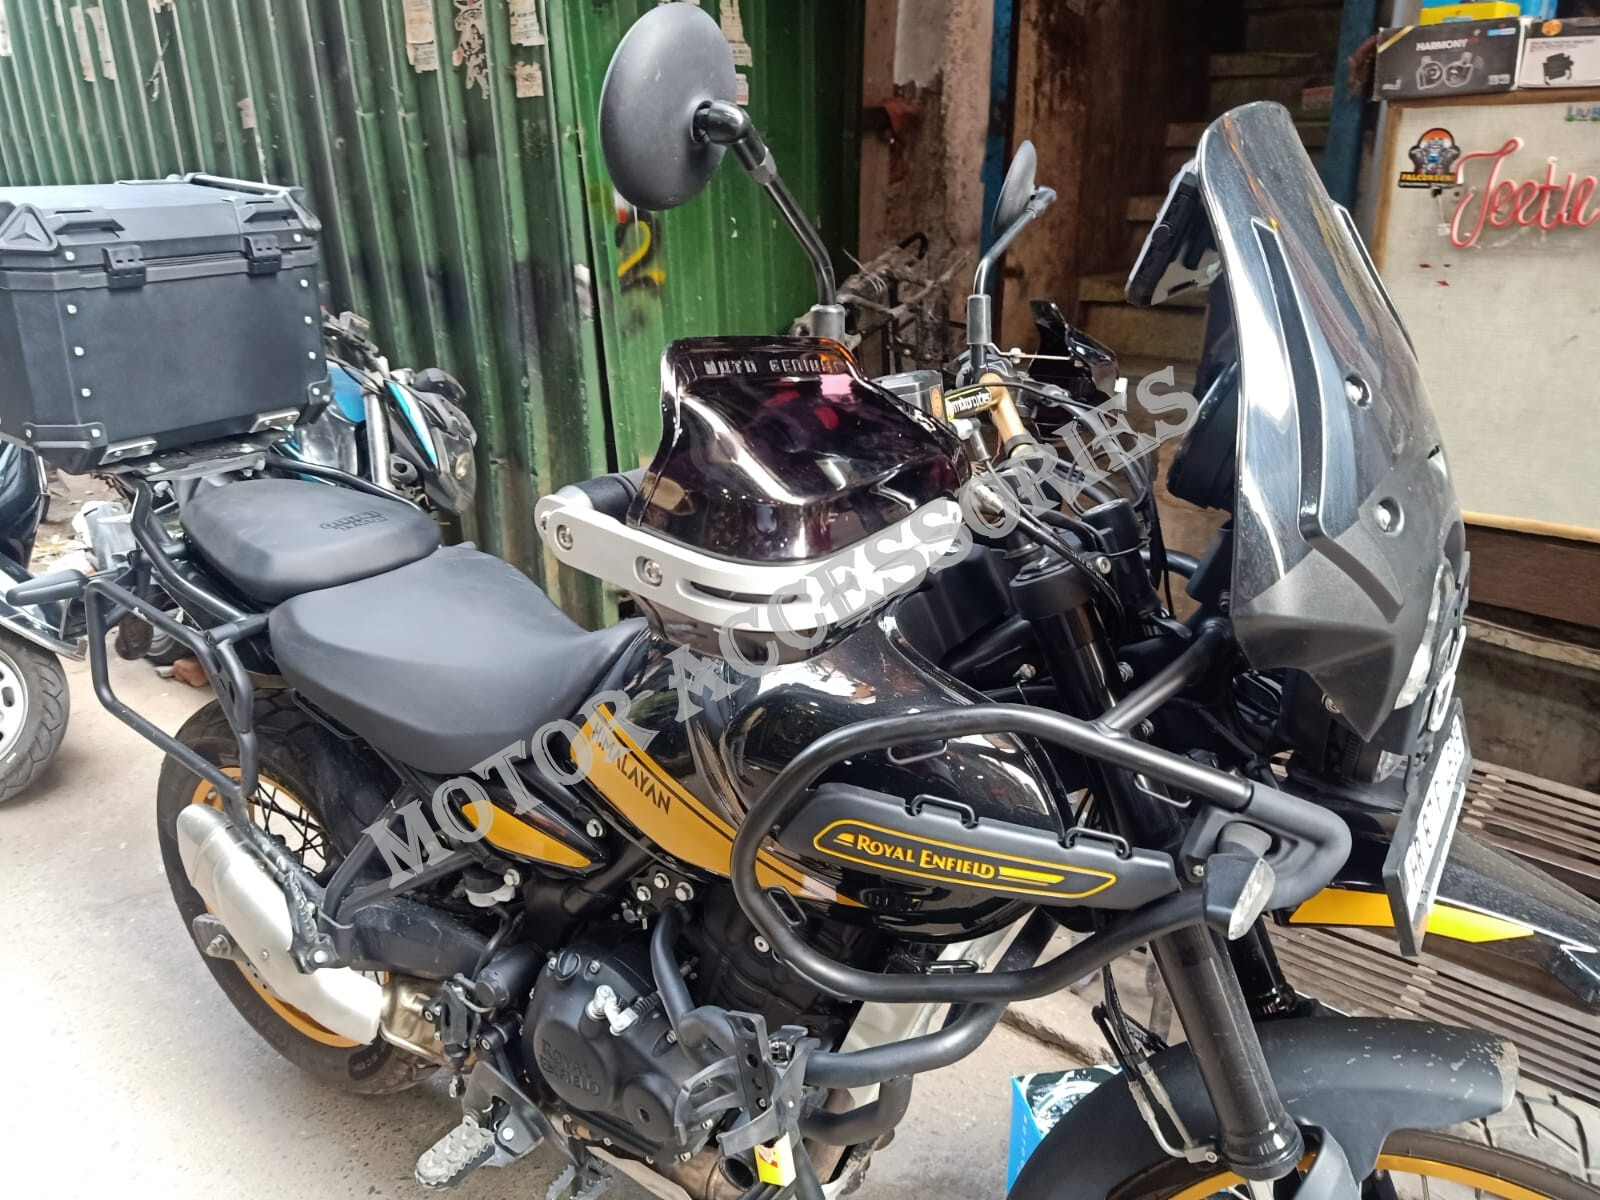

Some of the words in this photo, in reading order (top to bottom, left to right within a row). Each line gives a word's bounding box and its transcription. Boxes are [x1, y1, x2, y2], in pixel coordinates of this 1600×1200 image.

[1415, 38, 1468, 51] HARMONY
[856, 833, 916, 863] ROYAL
[919, 849, 996, 879] ENFIELD
[541, 1038, 592, 1079] ROYAL
